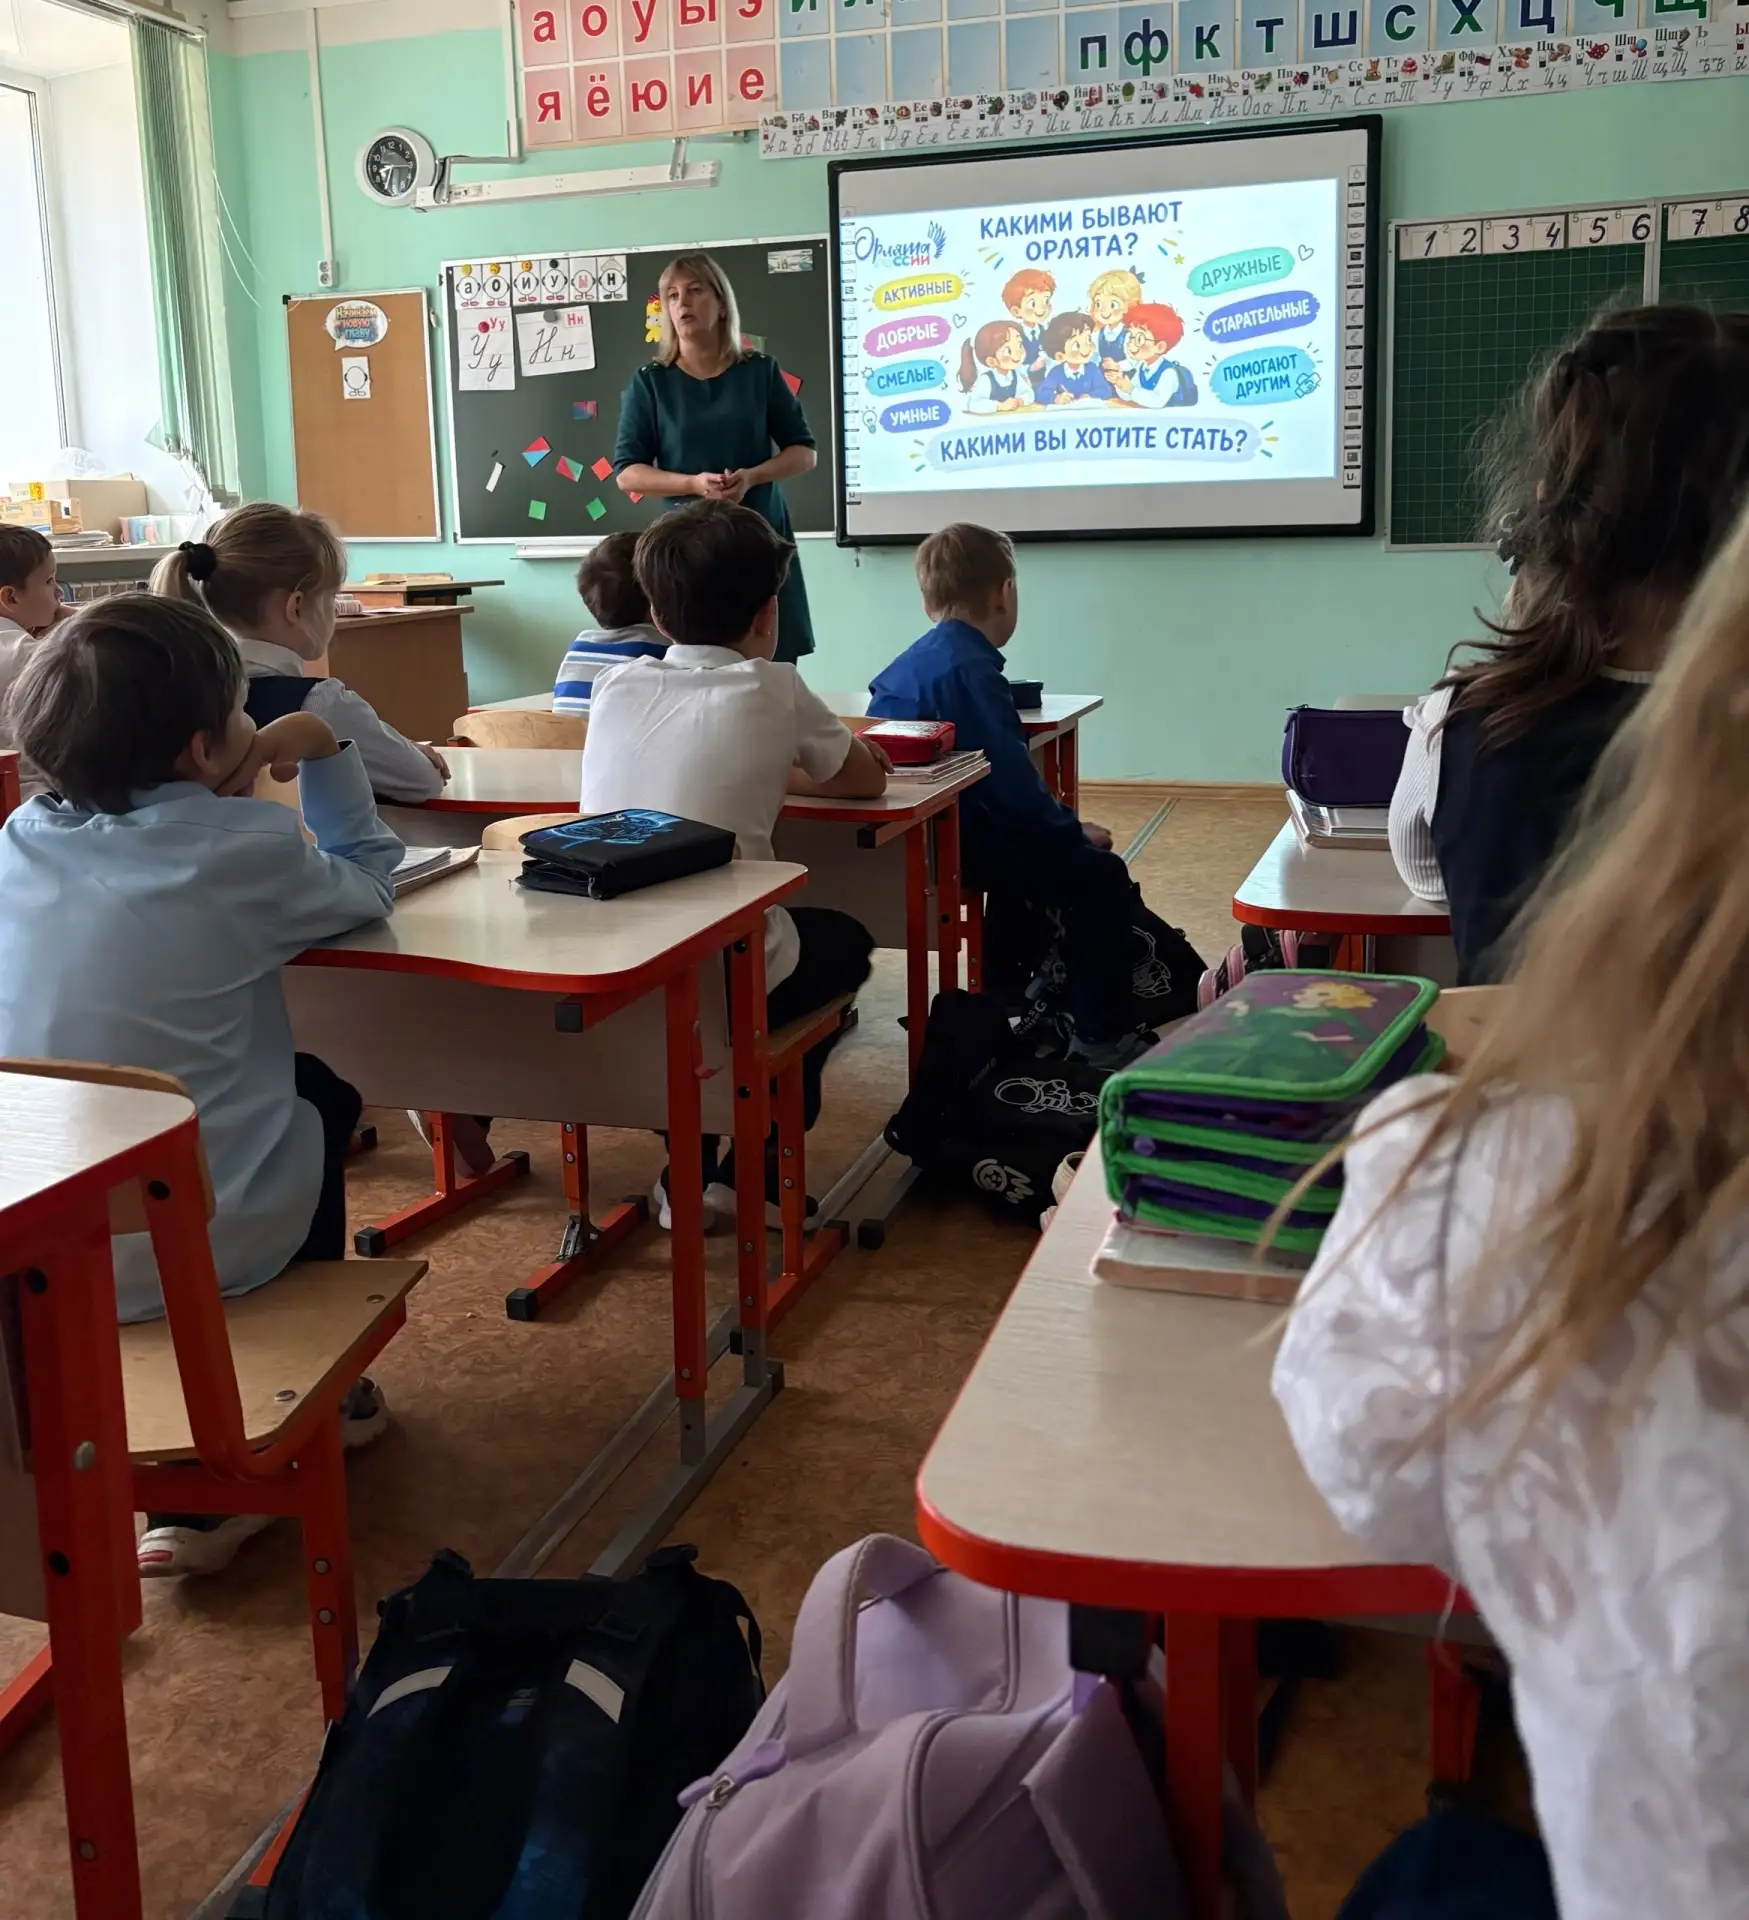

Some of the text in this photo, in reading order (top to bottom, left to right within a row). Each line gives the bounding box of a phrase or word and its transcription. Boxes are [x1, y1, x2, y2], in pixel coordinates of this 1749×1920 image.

[533, 10, 556, 42] а
[582, 5, 608, 36] о
[631, 0, 656, 43] у
[1080, 34, 1108, 70] п
[1124, 18, 1169, 76] ф
[1313, 10, 1357, 48] ш
[536, 68, 764, 123] я ё ю и е
[792, 113, 805, 123] Бб
[913, 102, 928, 112] Ее
[1106, 83, 1121, 93] Кк
[1242, 70, 1256, 80] Оо
[1313, 65, 1329, 78] Рр
[1348, 60, 1364, 72] Сс
[1459, 50, 1476, 65] Фф
[388, 141, 395, 149] 12
[980, 201, 1183, 240] КАКИМИ БЫВАЮТ
[1424, 205, 1749, 257] 1 2 3 4 5 6 7 8
[855, 226, 930, 264] Орлята
[1025, 232, 1139, 261] ОРЛЯТА?
[1201, 254, 1282, 290] ДРУЖНЫЕ
[884, 280, 953, 304] АКТИВНЫЕ
[1212, 299, 1311, 335] СТАРАТЕЛЬНЫЕ
[876, 322, 939, 352] ДОБРЫЕ
[877, 366, 935, 390] СМЕЛЫЕ
[1223, 354, 1298, 382] ПОМОГАЮТ
[1235, 374, 1291, 400] ДРУГИМ
[890, 405, 940, 426] УМНЫЕ
[940, 427, 1248, 462] КАКИМИ ВЫ ХОТИТЕ СТАТЬ?
